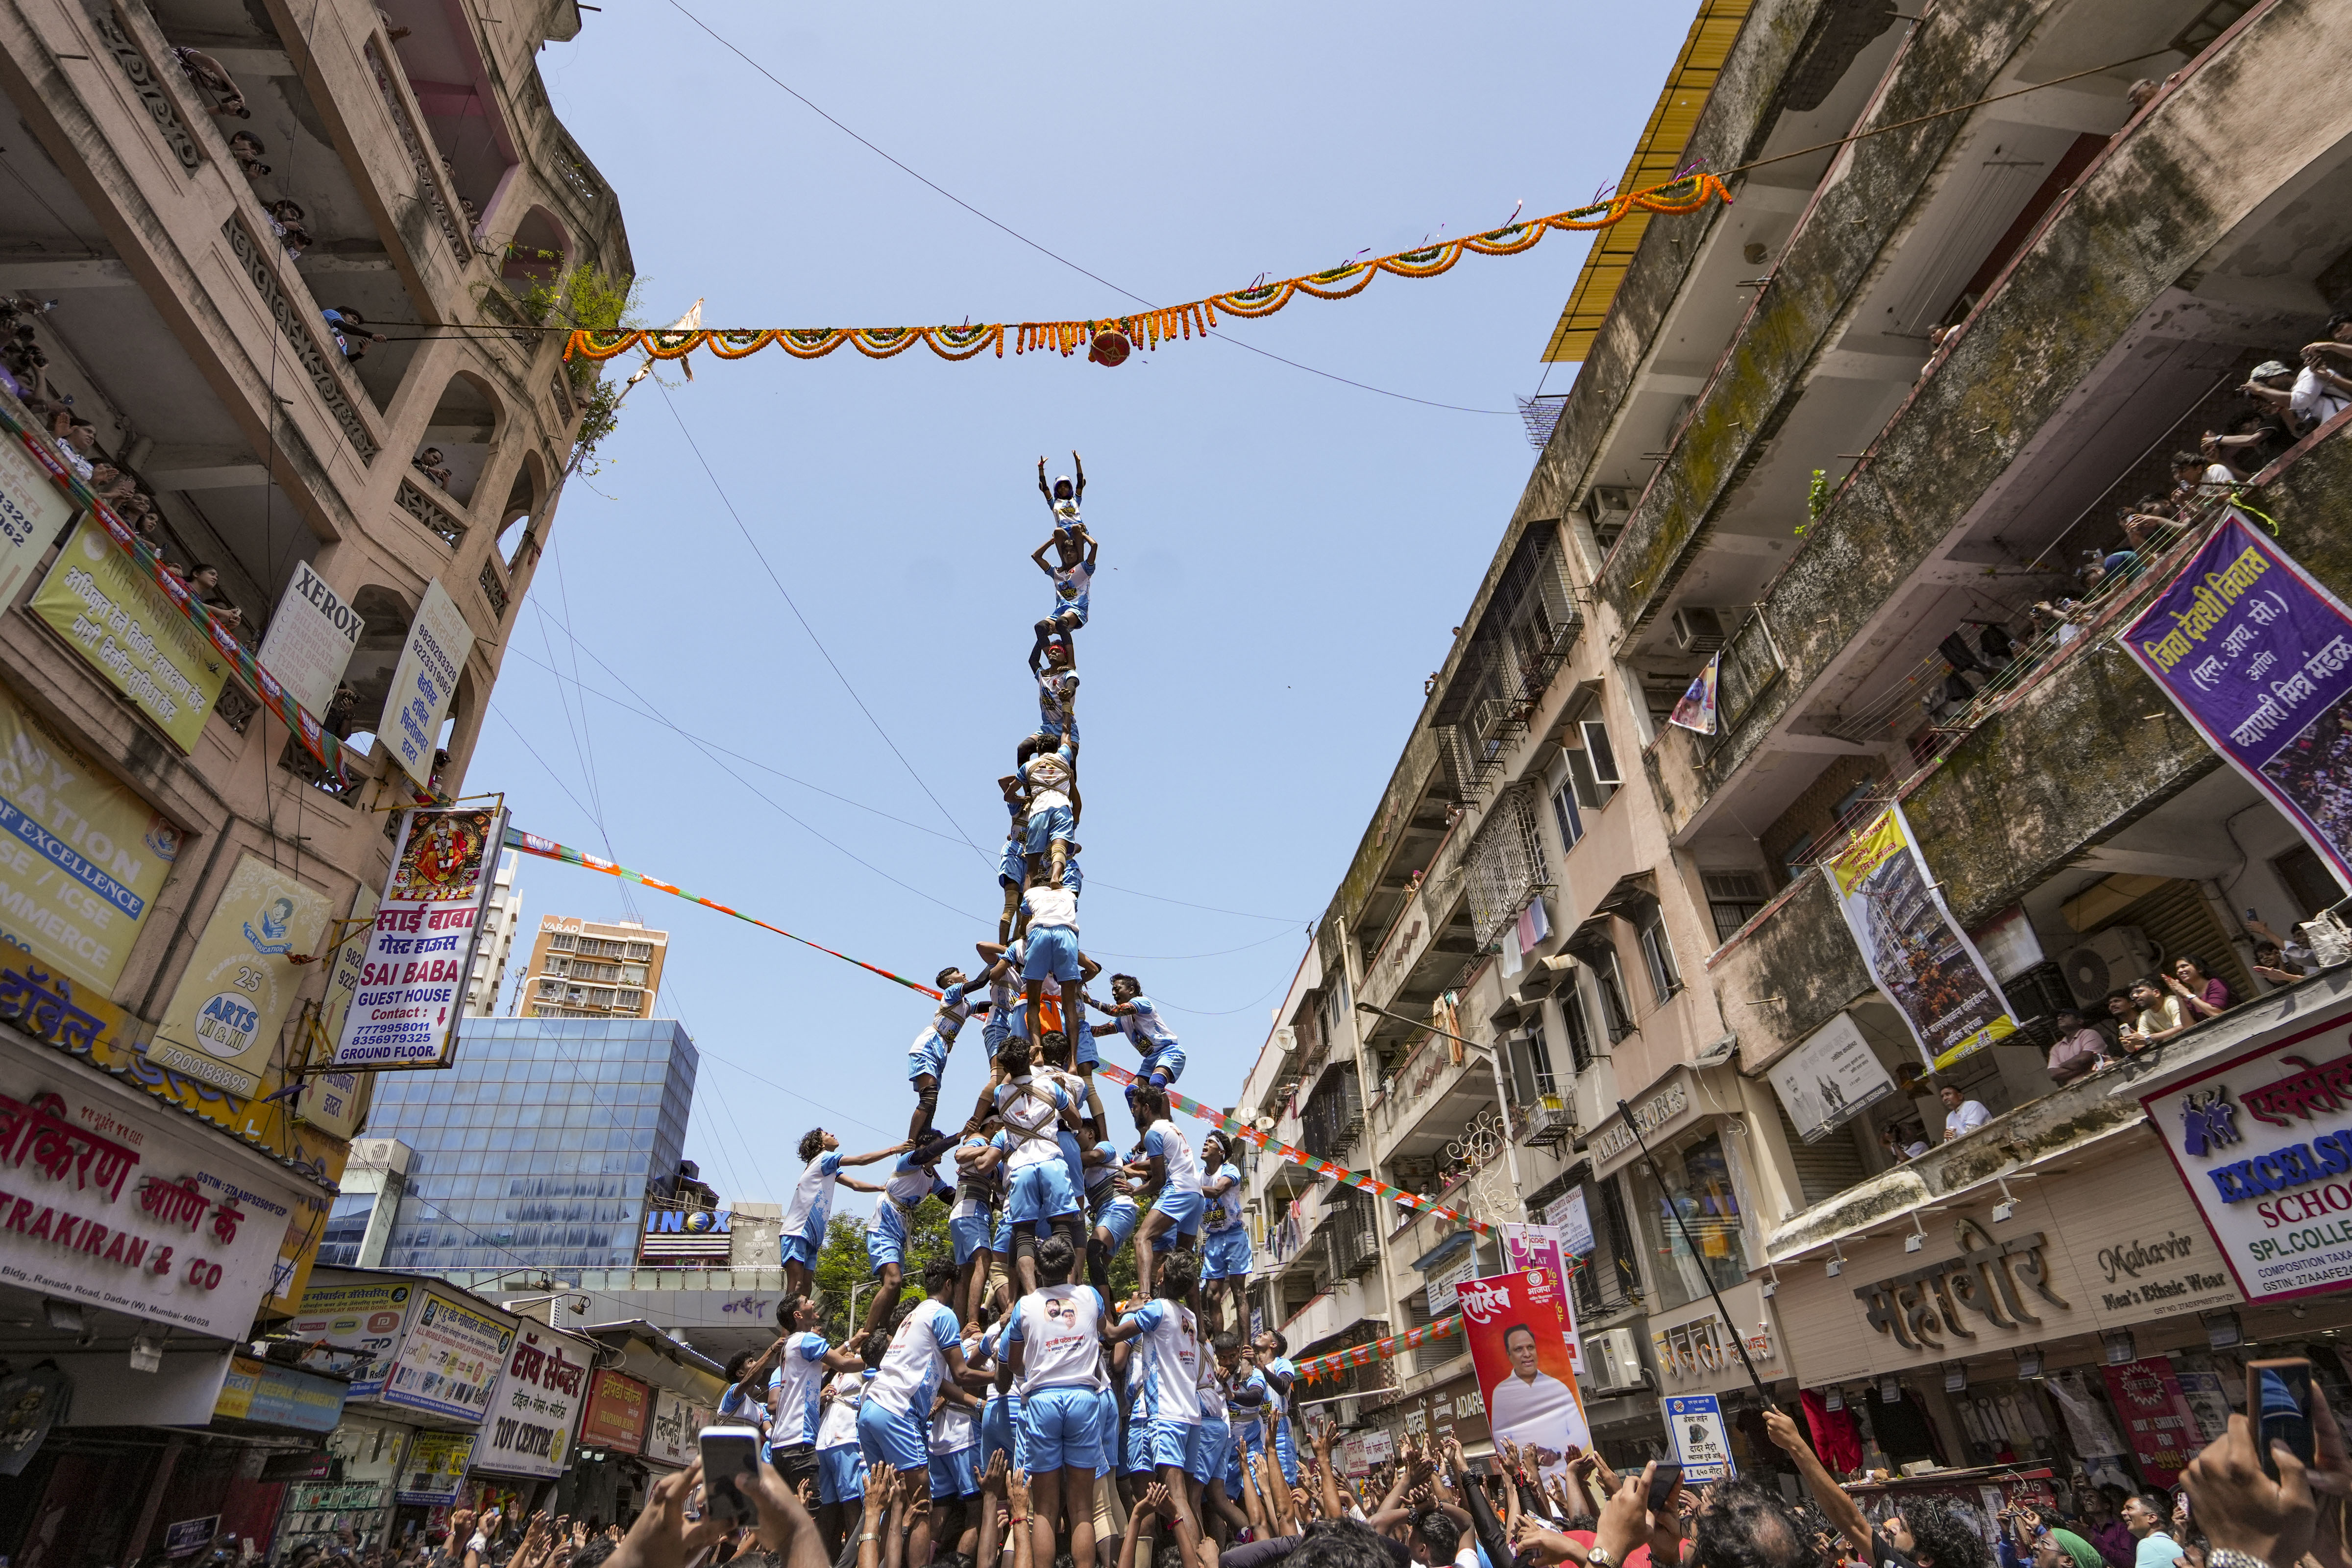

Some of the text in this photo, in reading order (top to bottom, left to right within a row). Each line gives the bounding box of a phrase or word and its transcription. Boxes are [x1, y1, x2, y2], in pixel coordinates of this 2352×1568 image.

[64, 565, 113, 617] अधिकृत
[295, 568, 362, 643] XEROX
[2170, 582, 2228, 643] देवशी
[2205, 545, 2270, 607] निवास
[294, 611, 334, 652] BILL BOOK
[299, 600, 351, 655] VISITING CARD
[281, 643, 312, 674] STANDY
[285, 633, 337, 683] FLEX DESIGNS
[290, 623, 335, 666] PAMPHLATE
[418, 623, 457, 683] 9820293329
[277, 653, 306, 683] TYPING
[413, 638, 452, 699] 9223319062
[2246, 650, 2278, 682] आणि
[271, 664, 313, 703] PRINTOUT
[2230, 634, 2352, 749] व्यापारी मित्र मंडळ
[18, 820, 142, 914] EXCELLENCE
[56, 882, 113, 931] ICSE
[376, 903, 428, 933] साई
[428, 907, 478, 930] बाबा
[246, 930, 285, 954] MY EDUCATION
[542, 921, 579, 932] VARAD
[379, 934, 459, 955] गेस्ट हाऊस
[206, 955, 237, 982] YEARS
[239, 953, 252, 963] OF
[233, 966, 264, 992] 25
[360, 959, 458, 986] SAI BABA
[358, 988, 452, 1006] GUEST HOUSE
[203, 996, 259, 1033] ARTS
[357, 1023, 430, 1035] 7779958011
[371, 1007, 421, 1021] Contact
[198, 1018, 247, 1051] XI & XII
[351, 1033, 431, 1045] 8356979325
[341, 1045, 436, 1060] GROUND FLOOR.
[160, 1047, 250, 1094] 7900188899
[1591, 1082, 1689, 1167] JANATA STORES
[196, 1172, 221, 1190] GSTIN
[141, 1176, 210, 1233] आणि
[153, 1246, 174, 1275] &
[188, 1258, 223, 1290] CO
[2098, 1230, 2192, 1284] Mahavir
[2257, 1255, 2324, 1279] COMPOSITION
[34, 1273, 73, 1293] Ranade
[75, 1284, 101, 1301] Road,
[103, 1293, 130, 1308] Dadar
[131, 1298, 148, 1312] (W),
[1527, 1285, 1551, 1296] भाजपा
[1853, 1218, 2070, 1351] महावीर
[2101, 1272, 2227, 1311] Men's Ethnic Wear
[2262, 1276, 2297, 1292] GSTIN:
[1460, 1281, 1512, 1324] साहेब
[2154, 1304, 2178, 1315] GST NO.
[416, 1326, 503, 1365] ALL MOBILE COMBO DISPLAY REPAIR DONE HERE
[511, 1332, 586, 1398] टॉय सेन्टर
[258, 1381, 294, 1399] DEEPAK
[295, 1389, 340, 1409] GARMENTS
[2126, 1378, 2156, 1391] OFFER
[600, 1410, 635, 1431] TRAPIADO JEANS
[1696, 1414, 1709, 1423] लाईन
[2132, 1415, 2184, 1431] BUY SHIRTS
[492, 1416, 519, 1450] TOY
[514, 1422, 554, 1458] CENTRE
[1689, 1442, 1717, 1454] दादर मेट्रो
[2156, 1433, 2175, 1446] FOR
[1704, 1452, 1713, 1462] पुढे
[1709, 1466, 1724, 1475] मीटर
